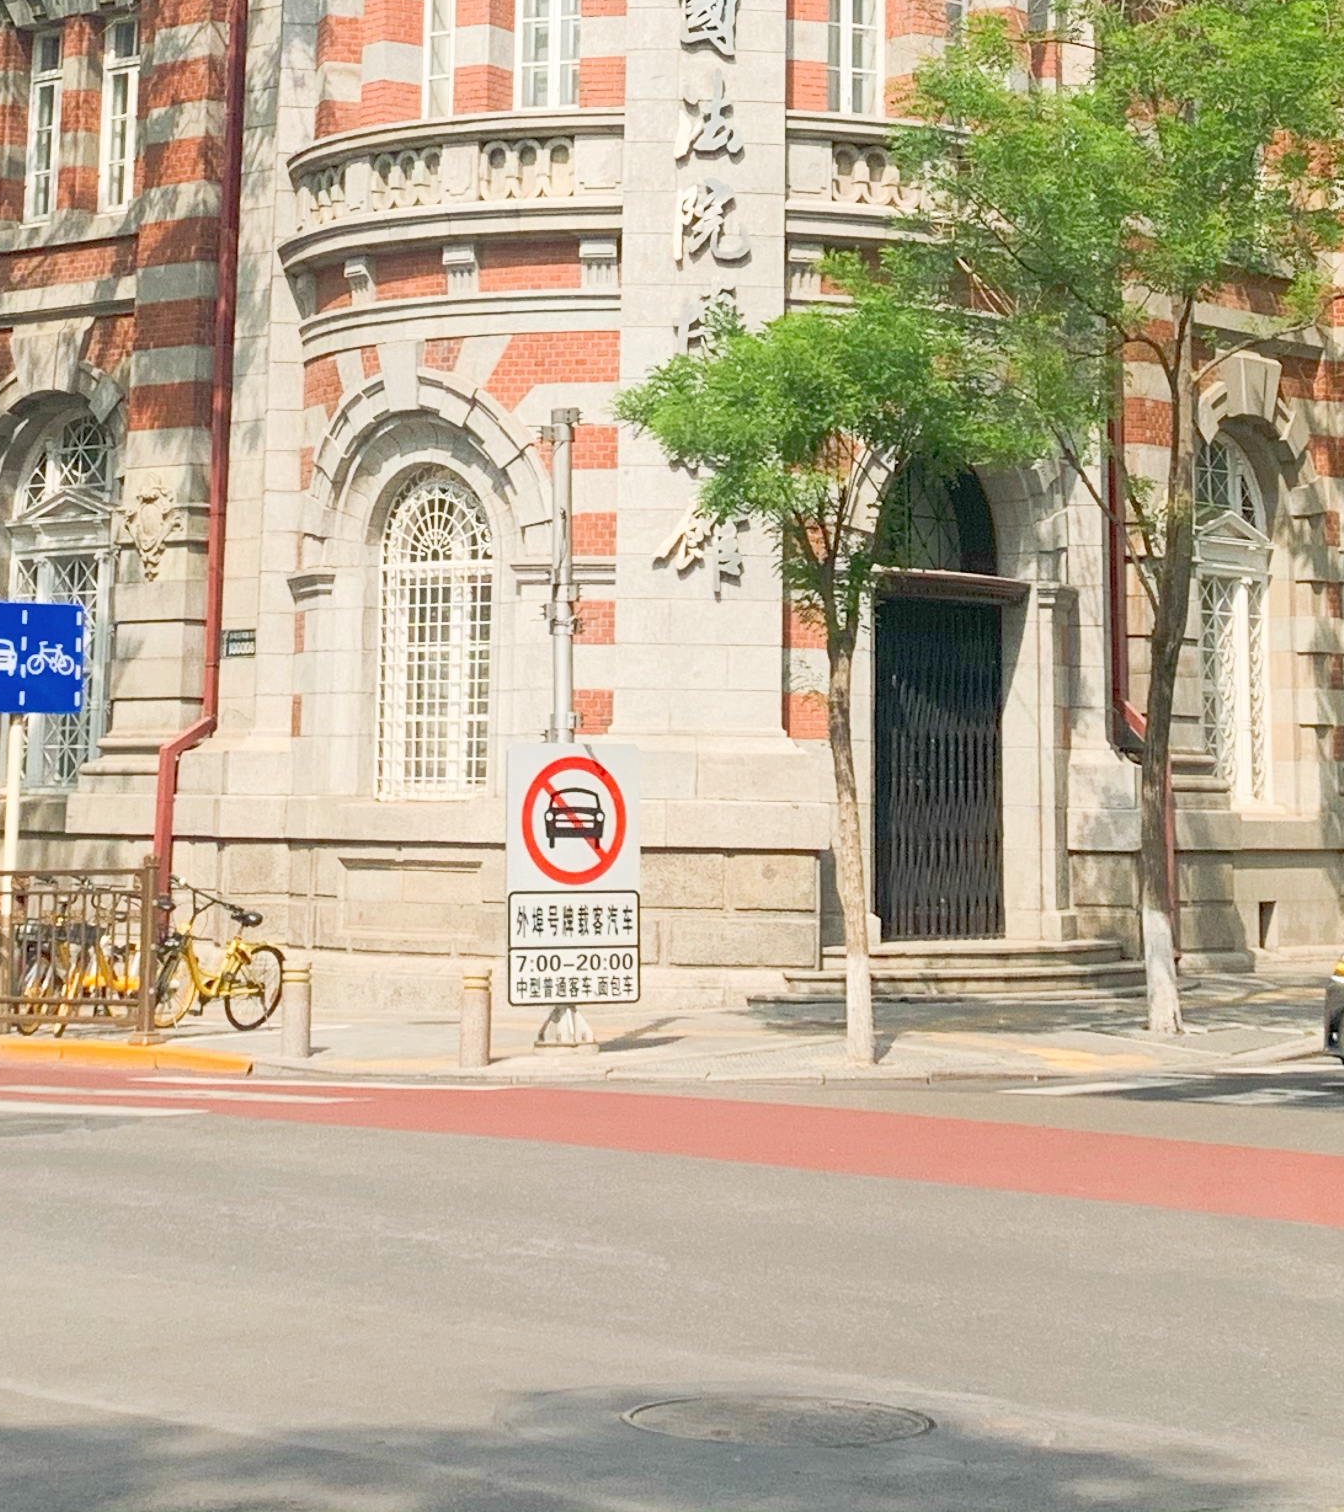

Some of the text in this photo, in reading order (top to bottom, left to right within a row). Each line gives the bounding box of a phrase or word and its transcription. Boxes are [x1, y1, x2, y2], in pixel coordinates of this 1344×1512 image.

[516, 904, 634, 938] 外埠号牌载客汽车
